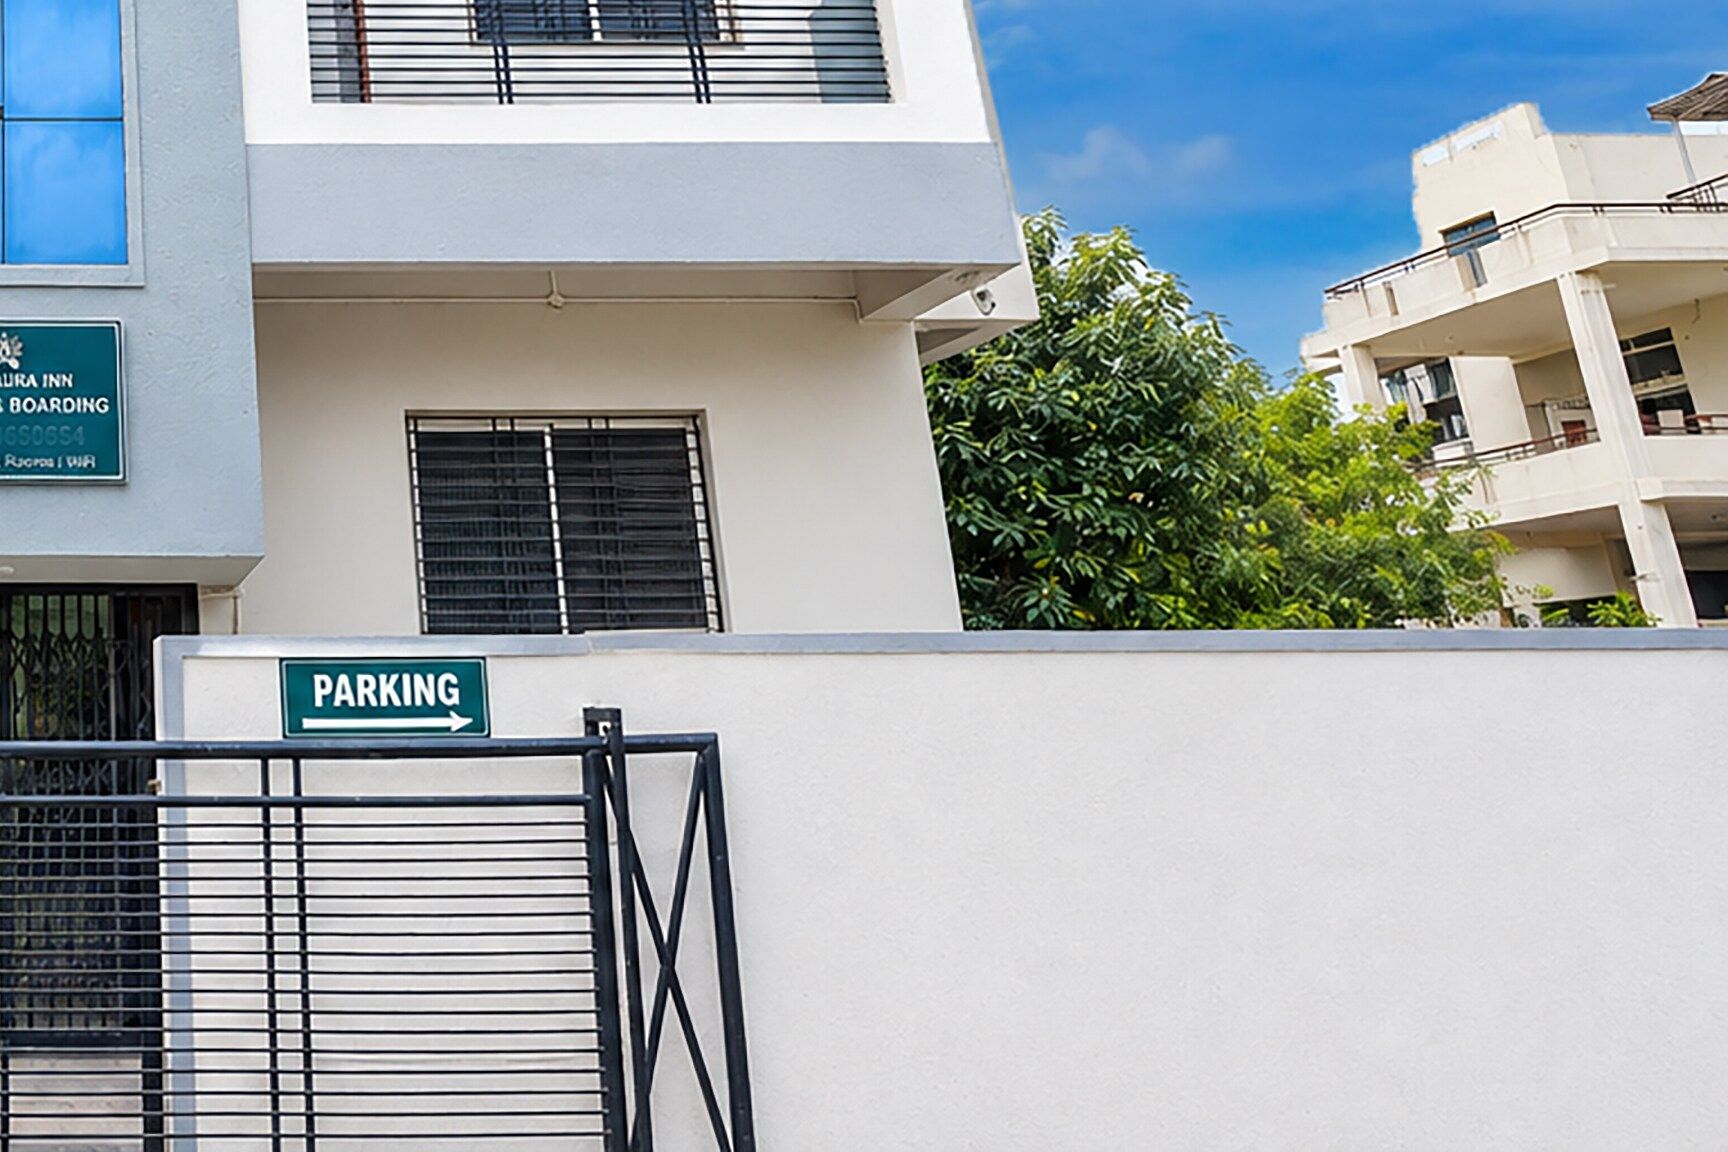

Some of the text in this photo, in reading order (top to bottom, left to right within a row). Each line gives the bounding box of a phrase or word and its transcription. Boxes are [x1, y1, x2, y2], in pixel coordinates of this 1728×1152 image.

[43, 373, 73, 388] INN
[9, 397, 109, 413] BOARDING
[313, 673, 460, 707] PARKING
